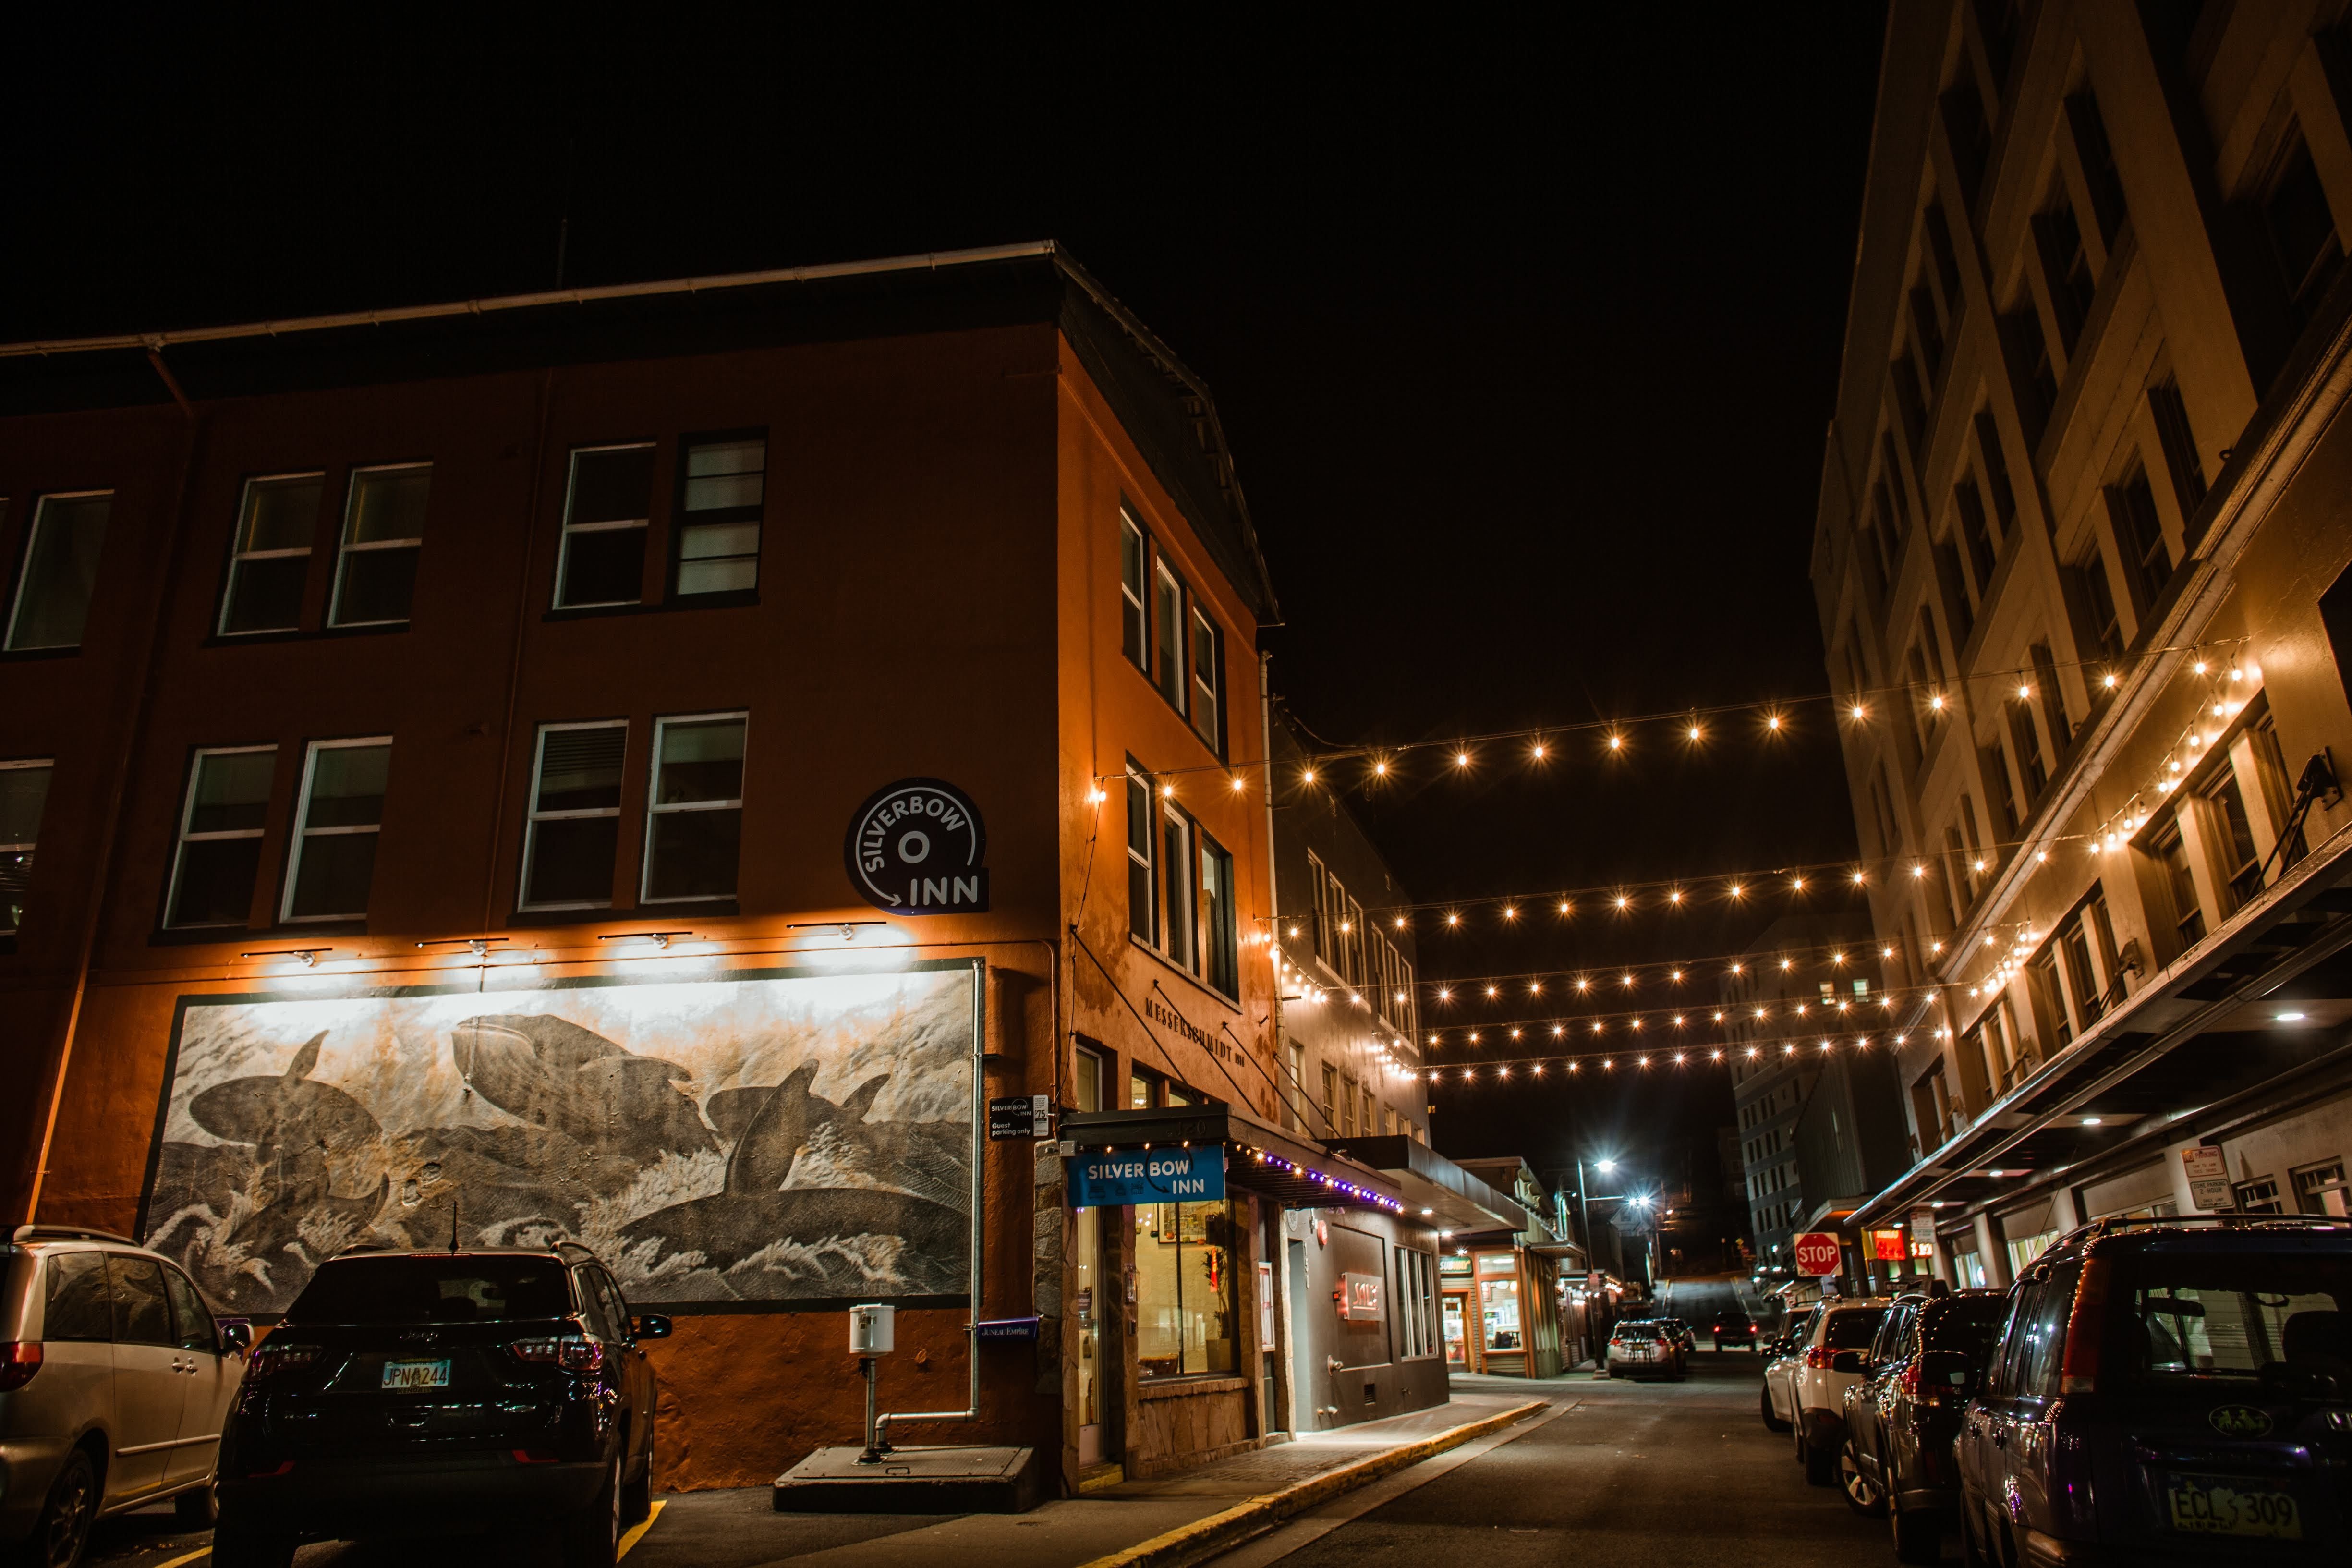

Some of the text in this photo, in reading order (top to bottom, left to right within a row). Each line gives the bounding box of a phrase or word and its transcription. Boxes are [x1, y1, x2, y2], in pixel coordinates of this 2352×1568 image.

[863, 796, 965, 873] SILVERBOW
[909, 875, 978, 907] INN
[1145, 997, 1232, 1062] MESSERSCHMIDT
[1034, 1109, 1046, 1118] $75
[992, 1129, 1016, 1137] parking
[1173, 1179, 1205, 1195] INN
[1798, 1245, 1837, 1263] STOP
[1439, 1259, 1471, 1271] SUBWAY
[982, 1327, 1029, 1337] JUNEAU EMPIRE
[383, 1367, 447, 1386] JPN 244
[2174, 1489, 2292, 1527] ECL 309
